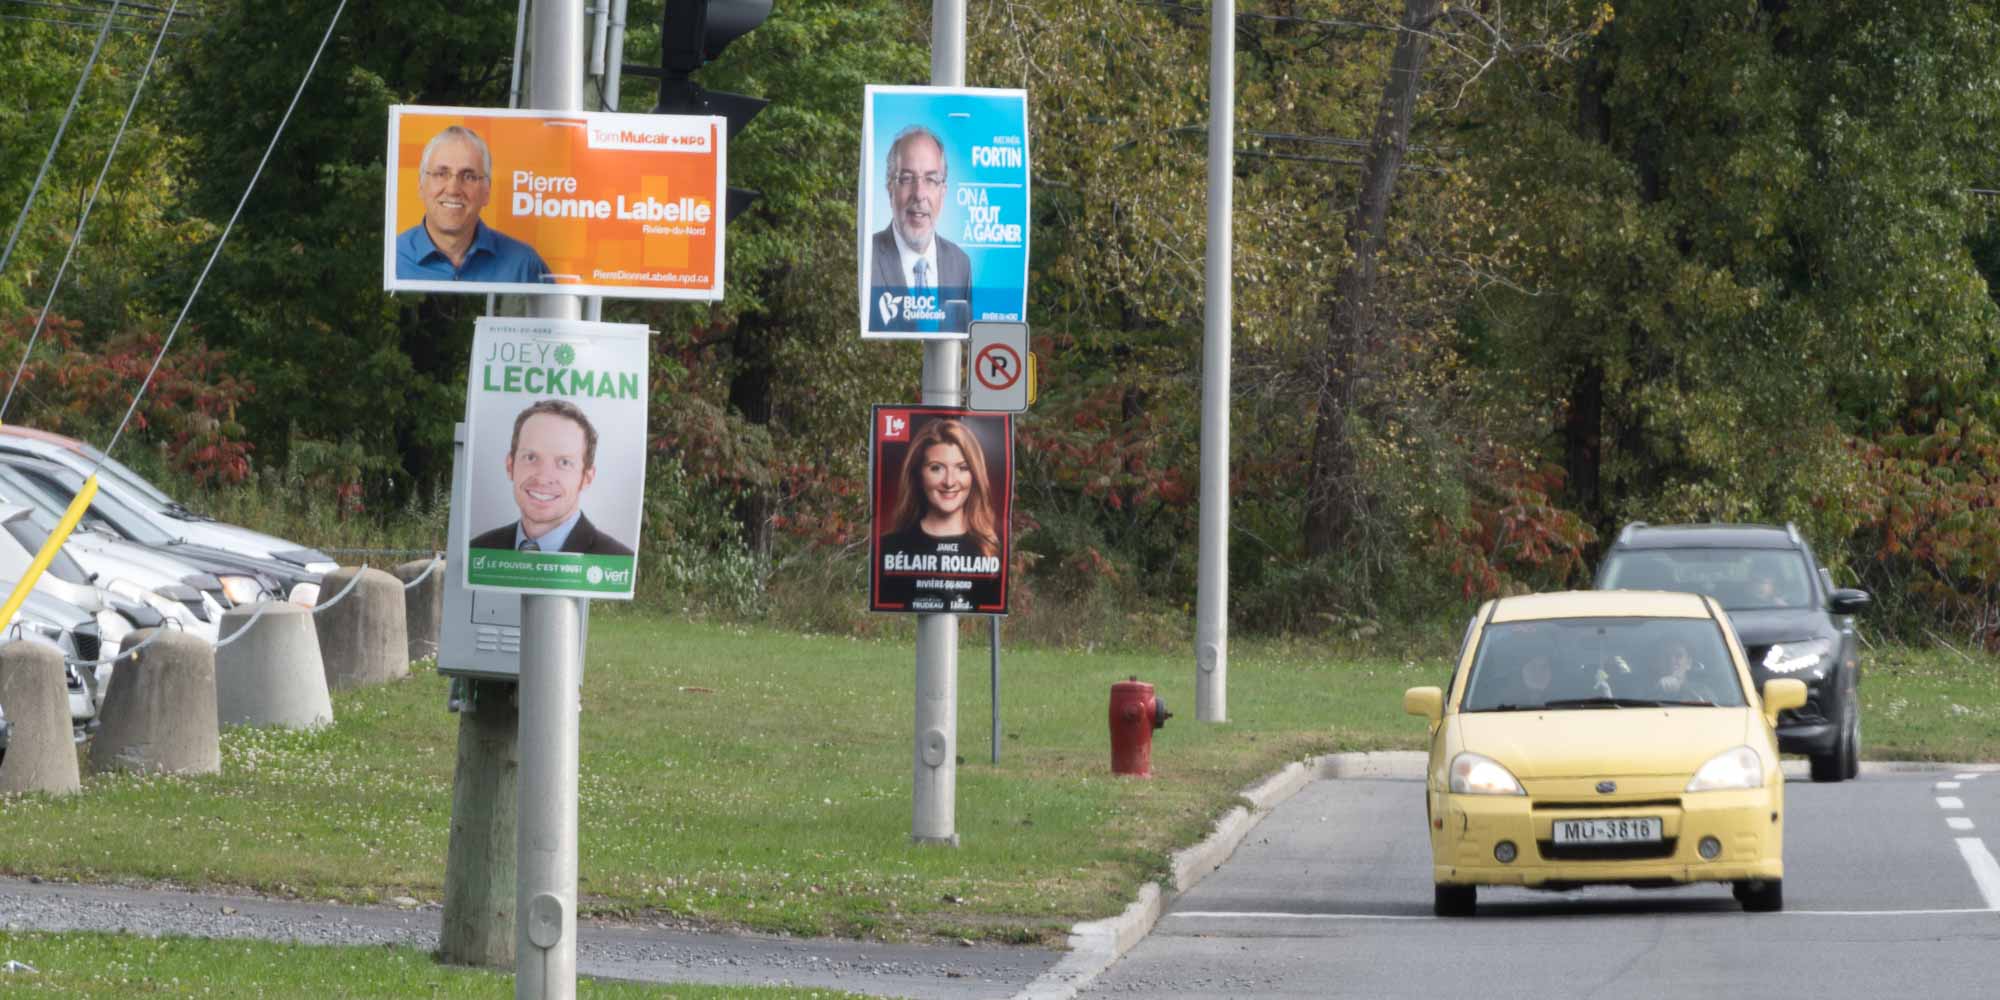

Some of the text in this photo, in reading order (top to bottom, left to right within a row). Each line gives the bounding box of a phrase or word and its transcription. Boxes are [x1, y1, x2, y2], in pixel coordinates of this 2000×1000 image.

[593, 129, 618, 143] Tom
[620, 131, 669, 145] Mulcair
[973, 146, 1021, 168] FORTIN
[512, 170, 577, 193] Pierre
[512, 192, 711, 223] Dionne Labelle
[957, 188, 978, 206] ON
[968, 205, 1001, 224] TOUT
[973, 223, 1022, 242] GAGNER
[903, 295, 936, 310] BLOC
[486, 342, 550, 363] JOEY
[991, 355, 1008, 378] P
[483, 365, 638, 399] LECKMAN
[936, 544, 959, 552] JANICE
[885, 551, 1000, 573] BÉLAIR ROLLAND
